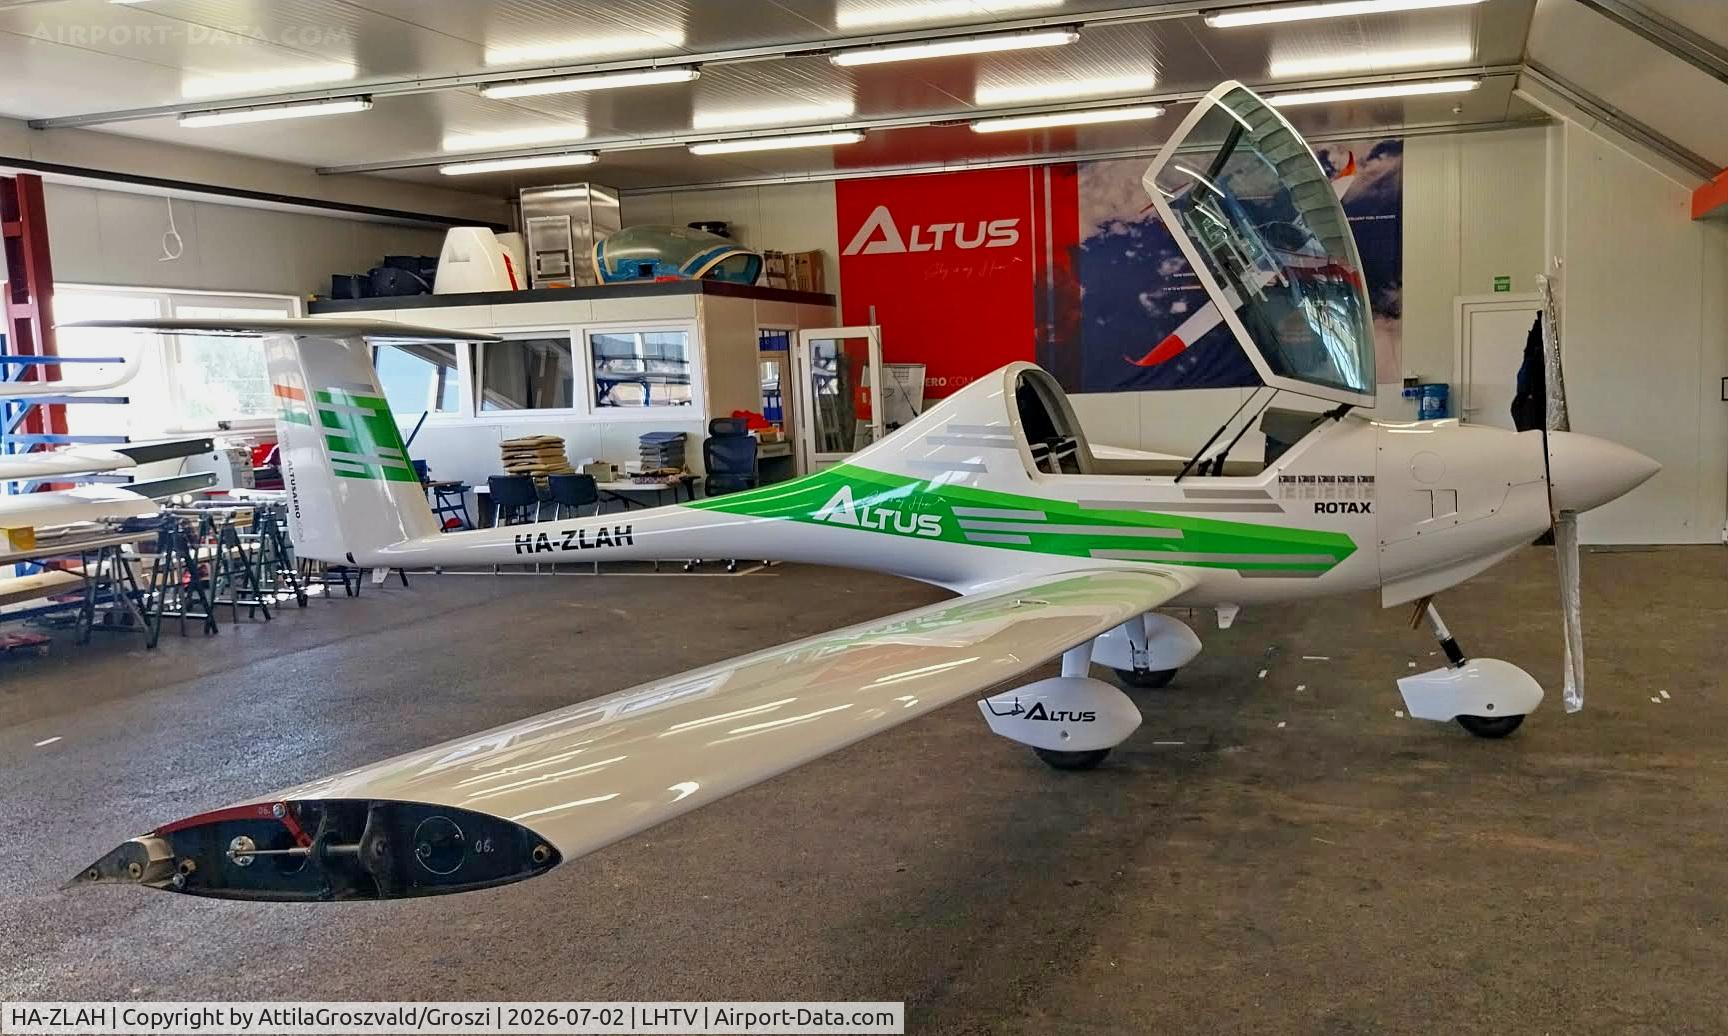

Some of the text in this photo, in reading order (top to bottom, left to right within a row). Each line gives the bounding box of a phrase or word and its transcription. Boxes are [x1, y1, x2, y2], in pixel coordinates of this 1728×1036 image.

[841, 205, 1021, 256] ALTUS
[812, 485, 944, 537] ALTUS
[1314, 502, 1371, 514] ROTAX
[514, 525, 634, 555] HA-ZLAH
[1023, 702, 1096, 722] ALTUS
